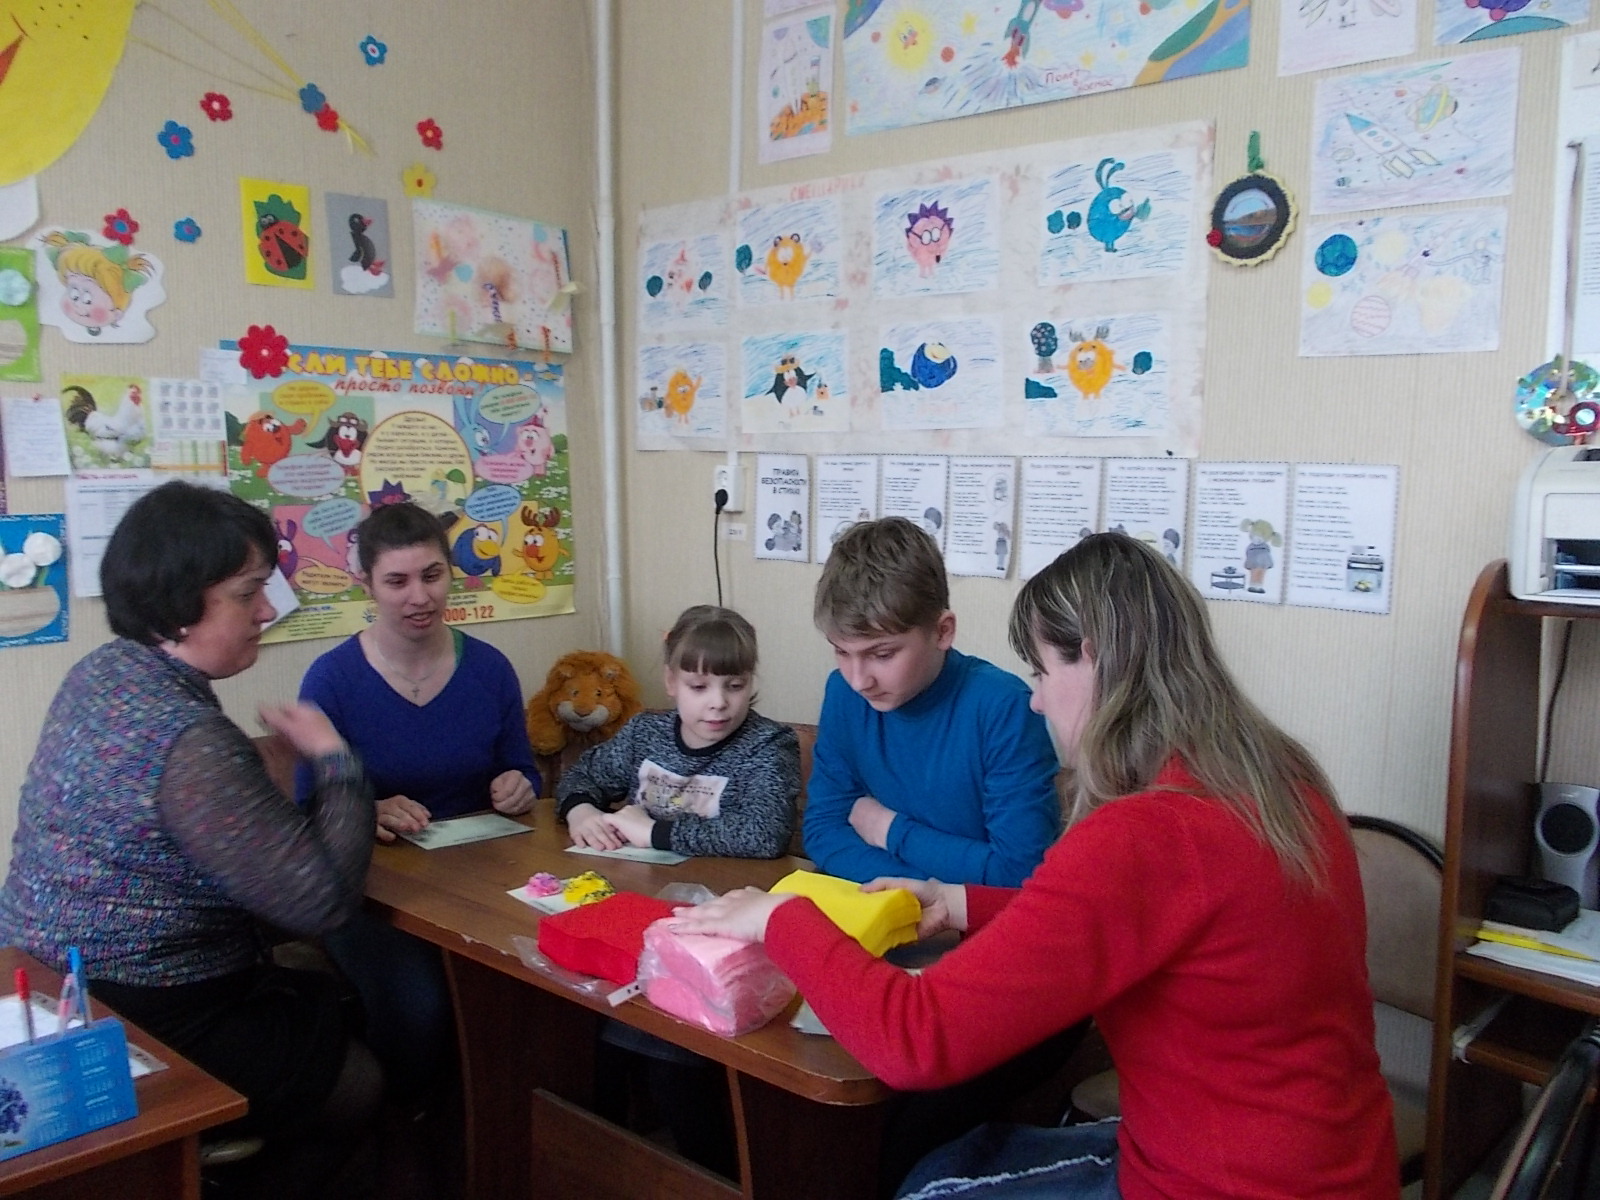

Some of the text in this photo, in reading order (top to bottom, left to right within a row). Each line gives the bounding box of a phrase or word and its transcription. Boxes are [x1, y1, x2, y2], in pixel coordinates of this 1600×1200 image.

[285, 352, 347, 376] СЛИ
[354, 356, 413, 380] ТЕБЕ
[421, 360, 519, 385] СЛОЖНО
[334, 379, 400, 395] просто
